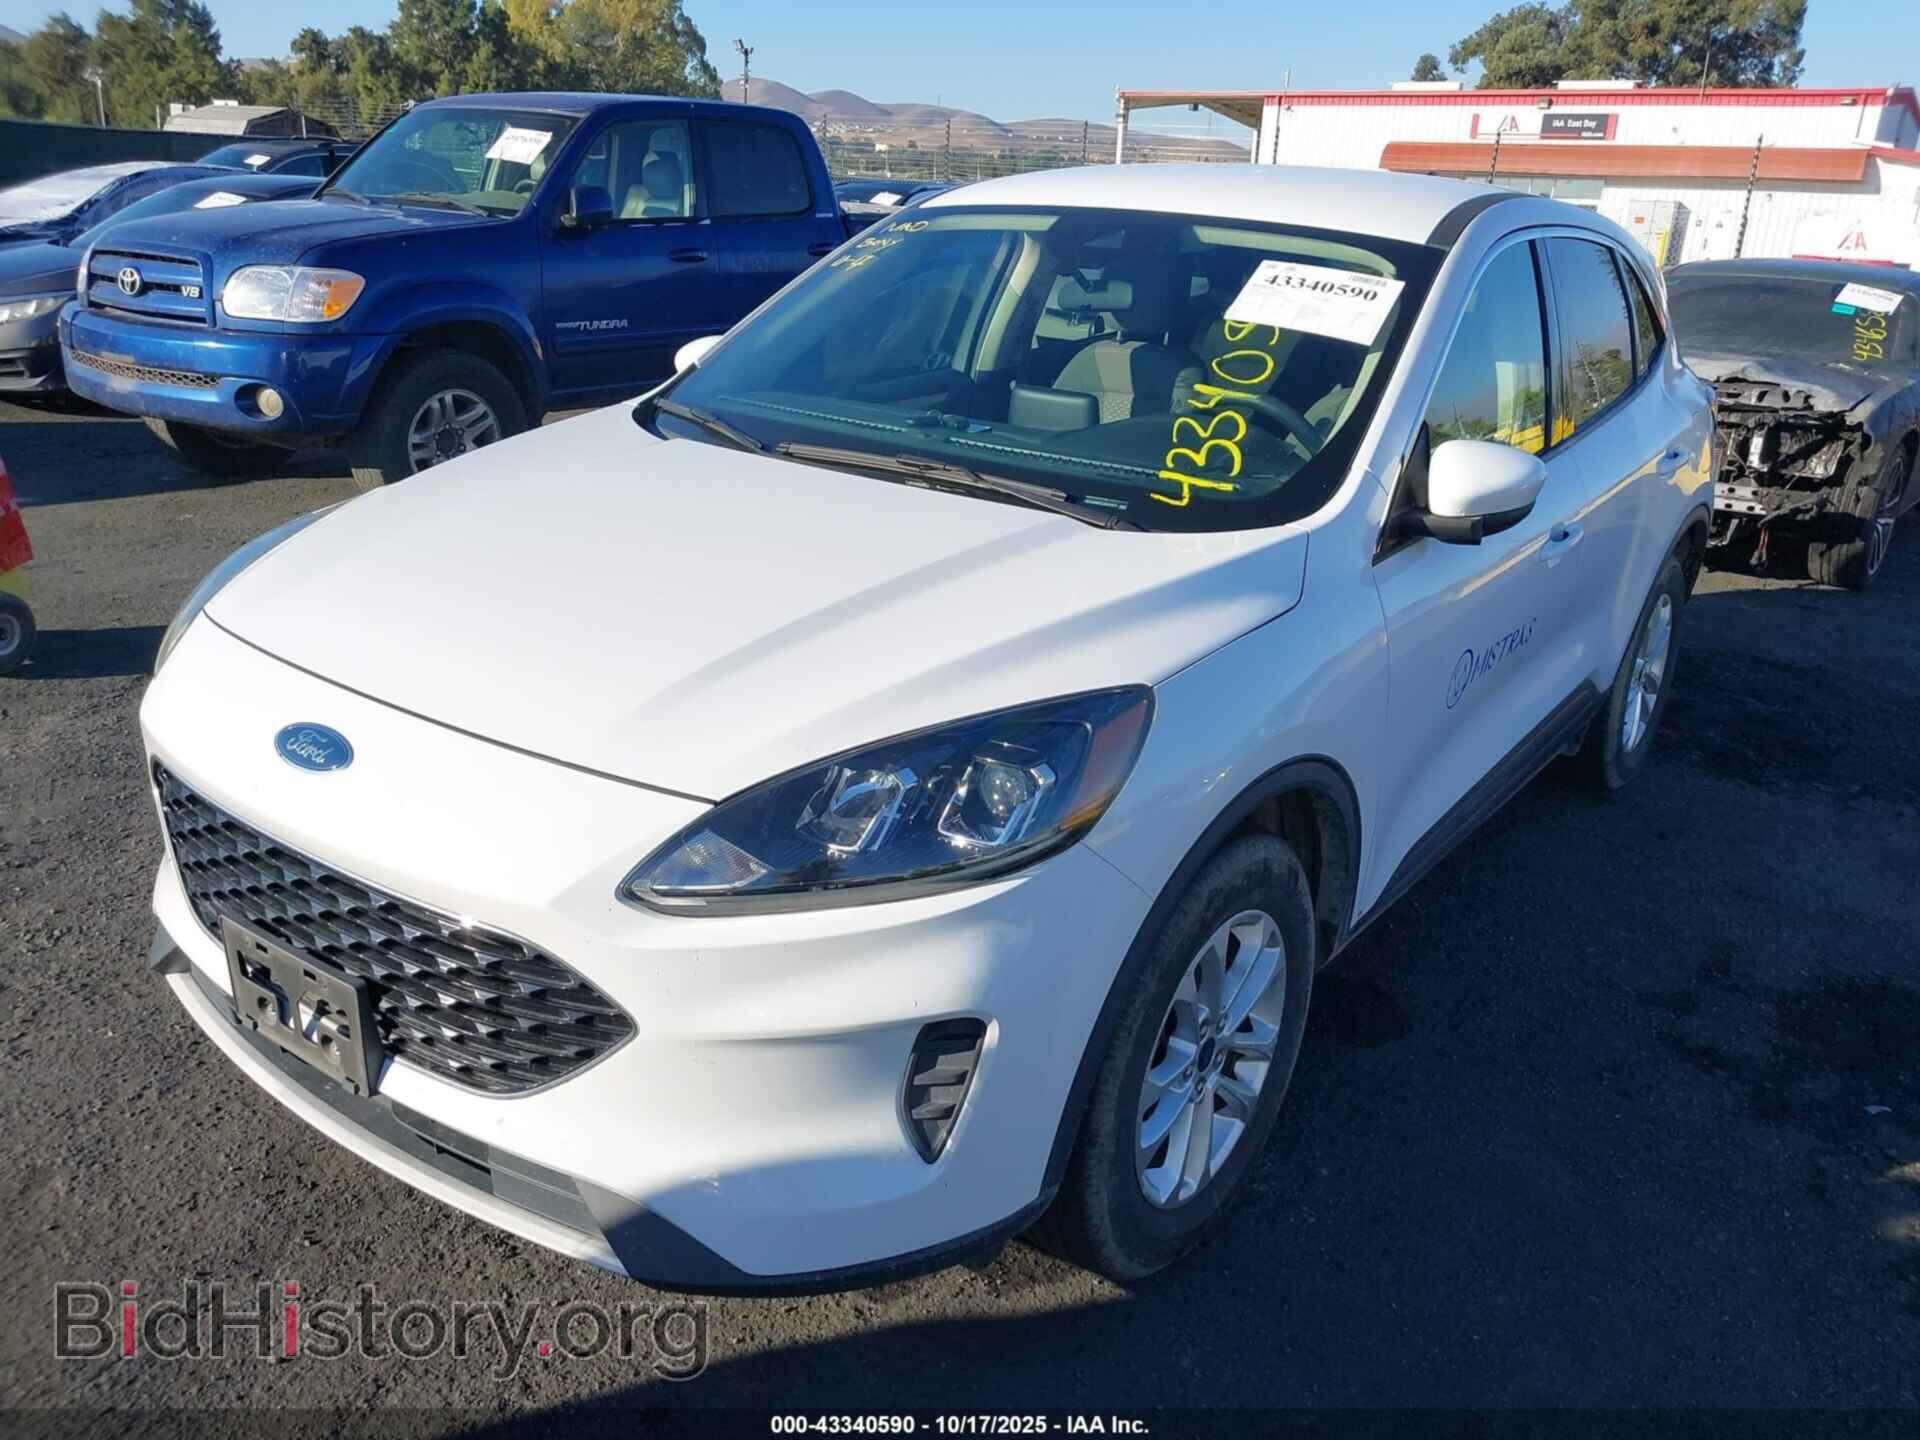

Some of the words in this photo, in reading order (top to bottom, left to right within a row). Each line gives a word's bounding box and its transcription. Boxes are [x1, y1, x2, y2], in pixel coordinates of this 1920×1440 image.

[1567, 119, 1582, 128] East
[1583, 119, 1597, 129] Bay
[181, 284, 201, 298] V8
[1264, 274, 1379, 302] 43340590
[577, 319, 629, 331] TUNDRA
[285, 729, 336, 764] Ford
